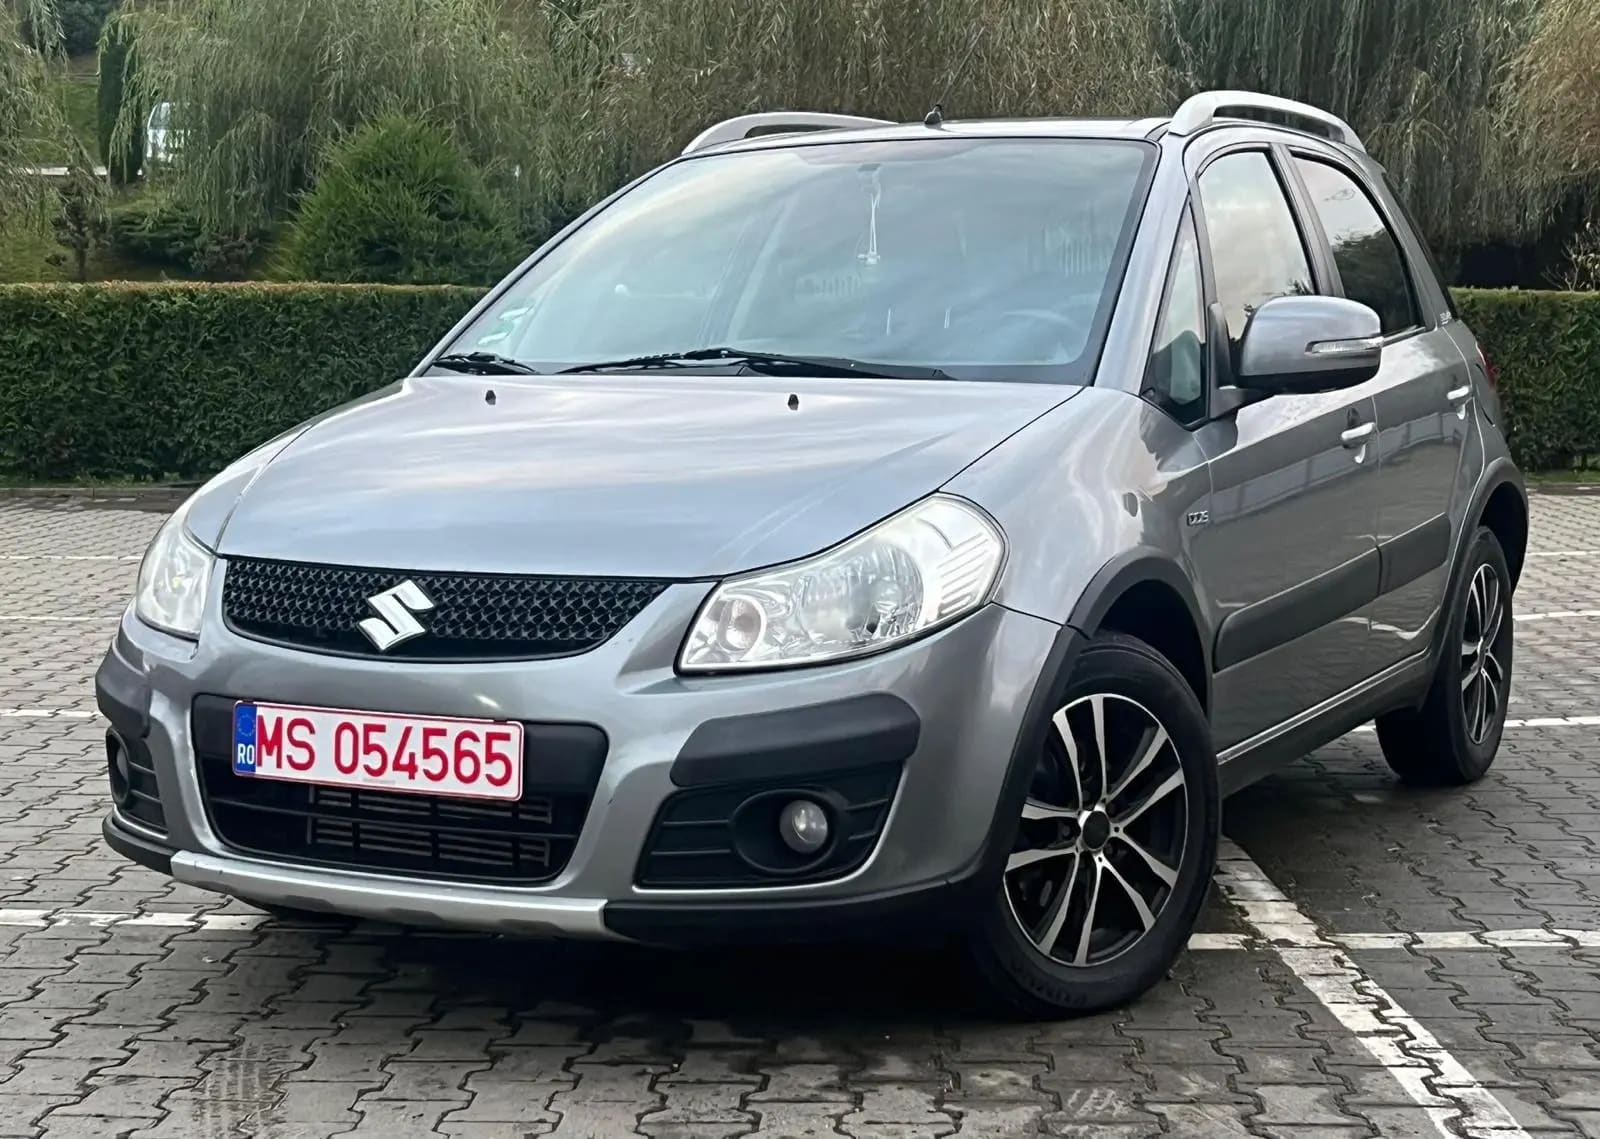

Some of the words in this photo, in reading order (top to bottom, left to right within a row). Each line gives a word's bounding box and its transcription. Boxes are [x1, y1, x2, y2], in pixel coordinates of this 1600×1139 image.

[237, 743, 255, 765] RO
[257, 715, 316, 771] MS
[334, 721, 513, 787] 054565
